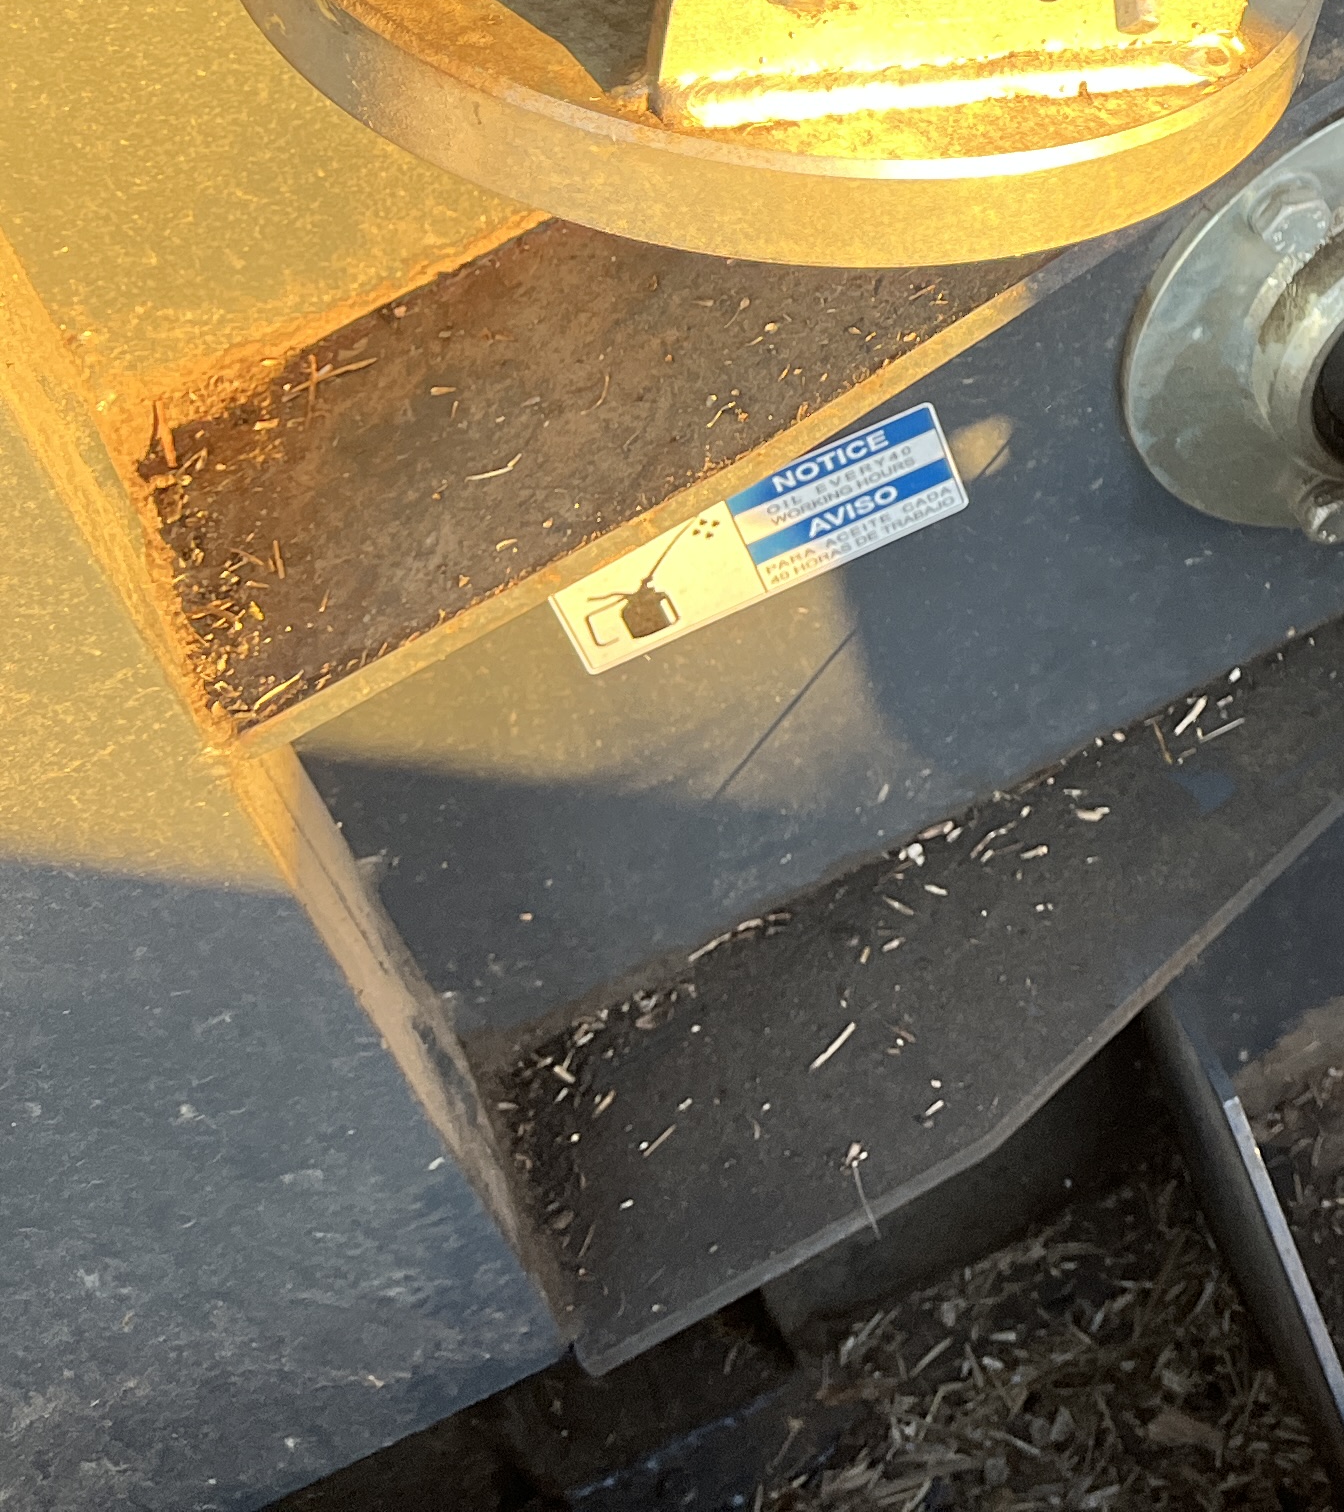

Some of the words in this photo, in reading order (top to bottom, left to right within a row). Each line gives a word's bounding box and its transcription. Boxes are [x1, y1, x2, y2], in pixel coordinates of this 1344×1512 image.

[770, 429, 889, 493] NOTICE
[766, 495, 802, 516] OIL
[770, 485, 853, 527] WORKING
[856, 457, 916, 490] HOURS
[809, 485, 898, 538] AVISO
[855, 533, 879, 548] DE
[882, 494, 956, 535] TRABAJO
